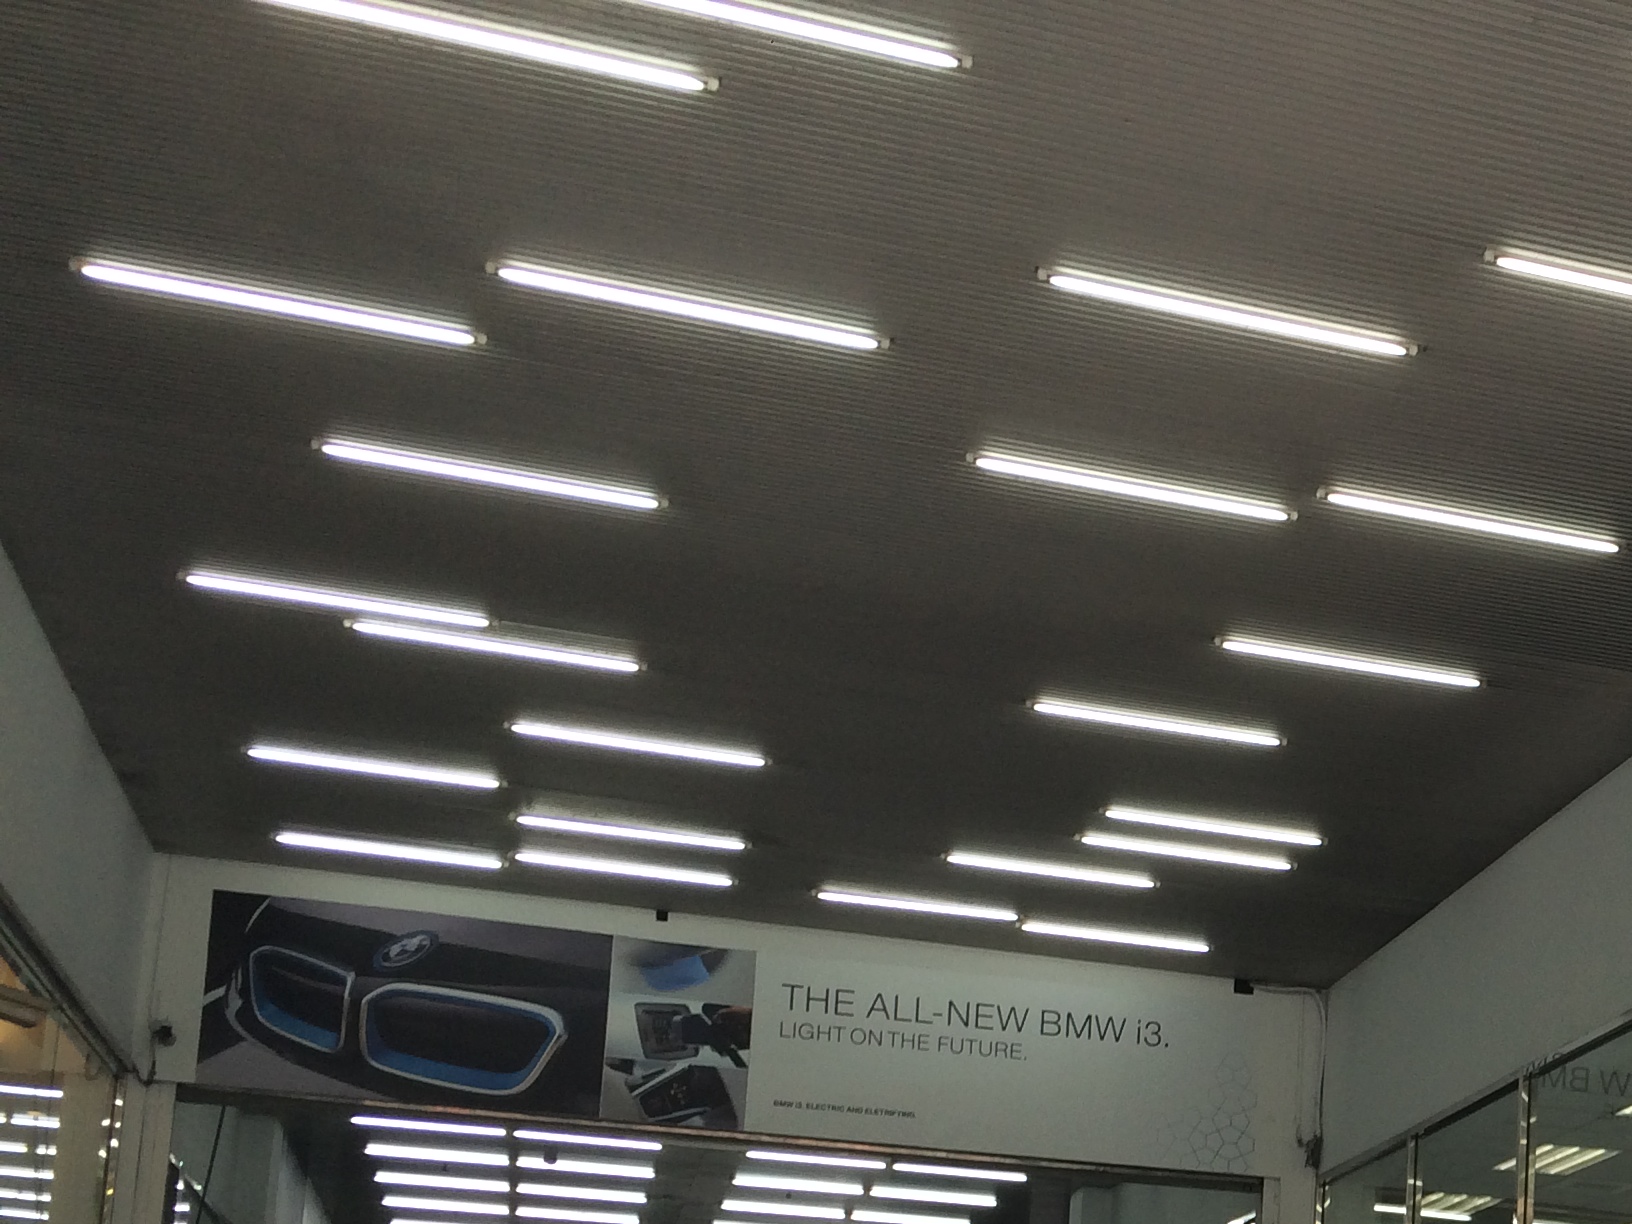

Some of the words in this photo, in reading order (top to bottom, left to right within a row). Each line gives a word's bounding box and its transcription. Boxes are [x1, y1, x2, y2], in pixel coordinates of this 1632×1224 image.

[782, 983, 855, 1017] THE
[866, 993, 1029, 1033] ALL-NEW
[1040, 1009, 1127, 1043] BMW
[1136, 1019, 1169, 1048] i3.
[779, 1021, 846, 1042] LIGHT
[850, 1028, 883, 1047] ON
[887, 1030, 930, 1052] THE
[937, 1036, 1027, 1061] FUTURE.
[806, 1102, 845, 1113] ELECTRIC
[846, 1106, 863, 1115] AND
